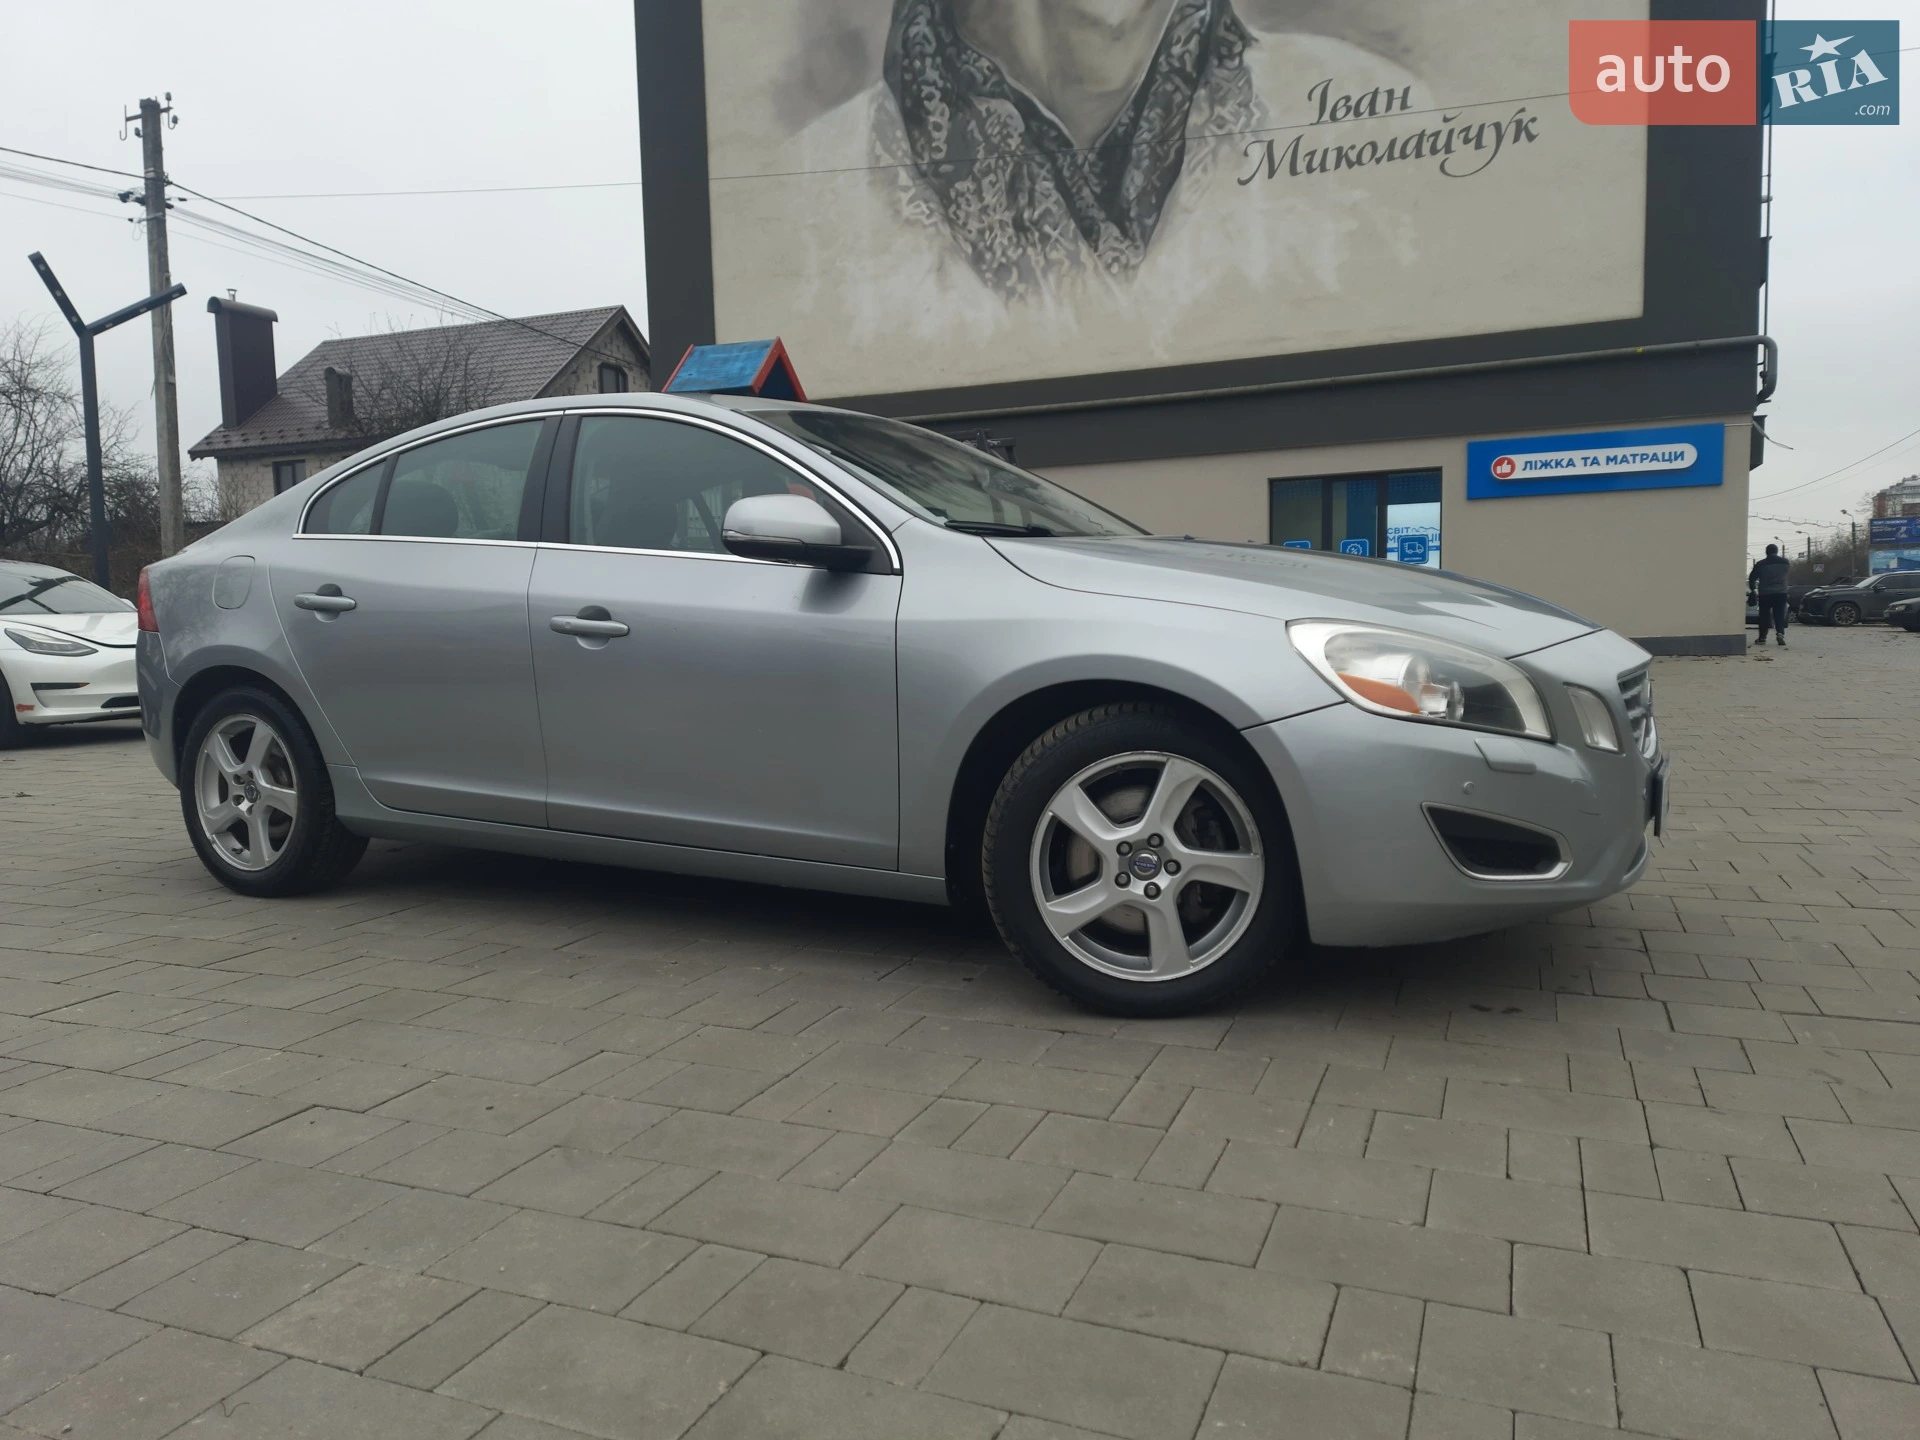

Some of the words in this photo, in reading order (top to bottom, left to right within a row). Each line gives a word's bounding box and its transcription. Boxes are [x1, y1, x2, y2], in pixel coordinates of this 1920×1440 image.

[1307, 78, 1413, 126] Іван
[1237, 106, 1540, 186] Миколайчук
[1522, 458, 1577, 472] ЛІЖКА
[1581, 456, 1601, 467] ТА
[1605, 450, 1685, 466] МАТРАЦИ
